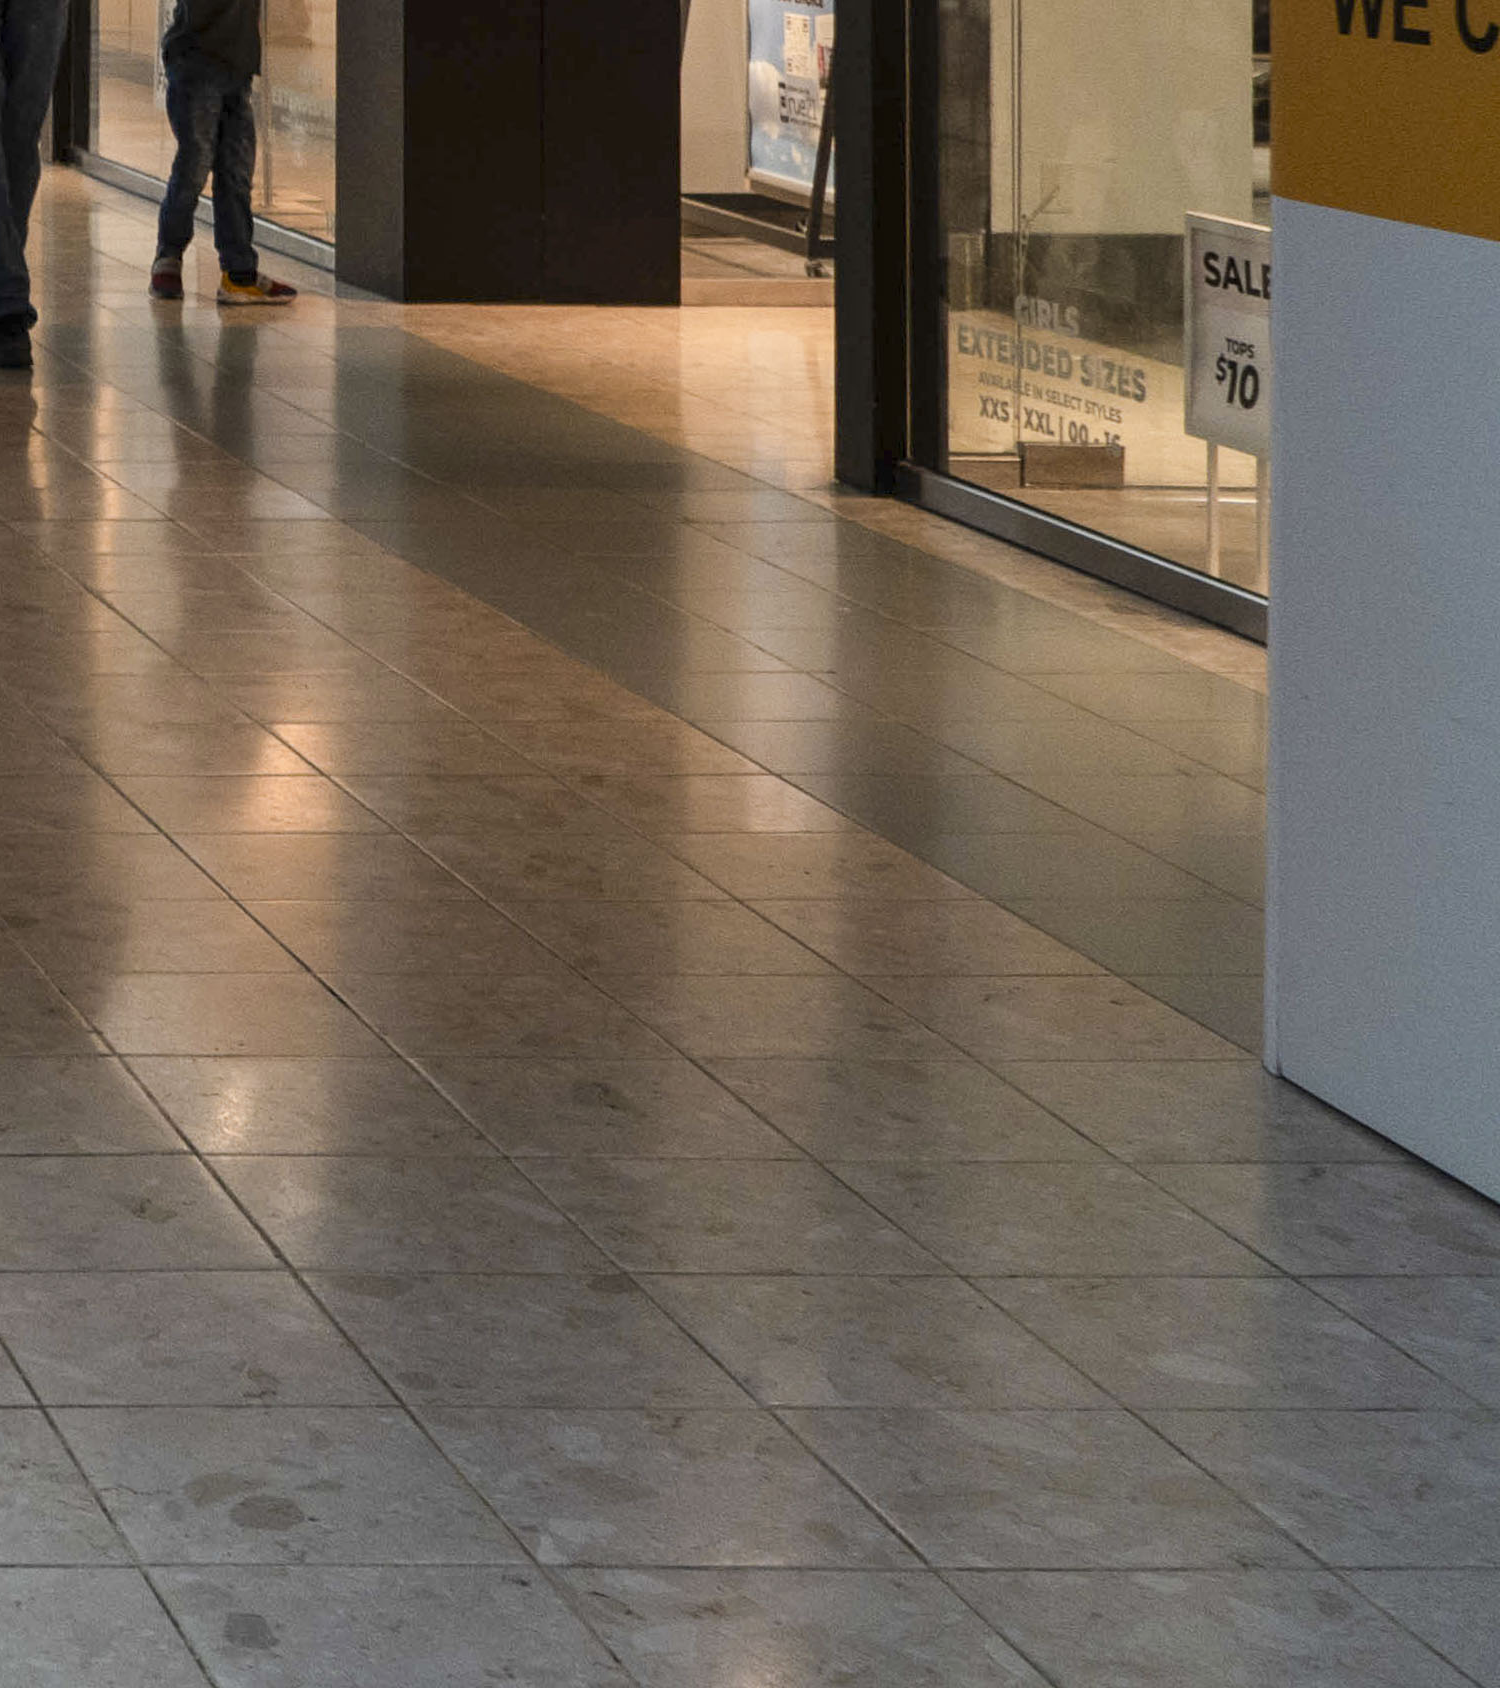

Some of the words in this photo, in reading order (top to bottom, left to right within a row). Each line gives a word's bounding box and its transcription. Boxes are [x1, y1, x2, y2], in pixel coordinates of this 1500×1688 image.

[1014, 295, 1080, 338] GIRLS
[958, 324, 1073, 380] EXTENDED
[1080, 354, 1146, 403] SIZES
[1226, 337, 1255, 360] TOPS
[1215, 353, 1260, 410] $10
[979, 395, 1010, 423] XXS
[1024, 407, 1054, 437] XXL
[1045, 390, 1083, 410] SELECT
[1085, 399, 1122, 425] STYLES
